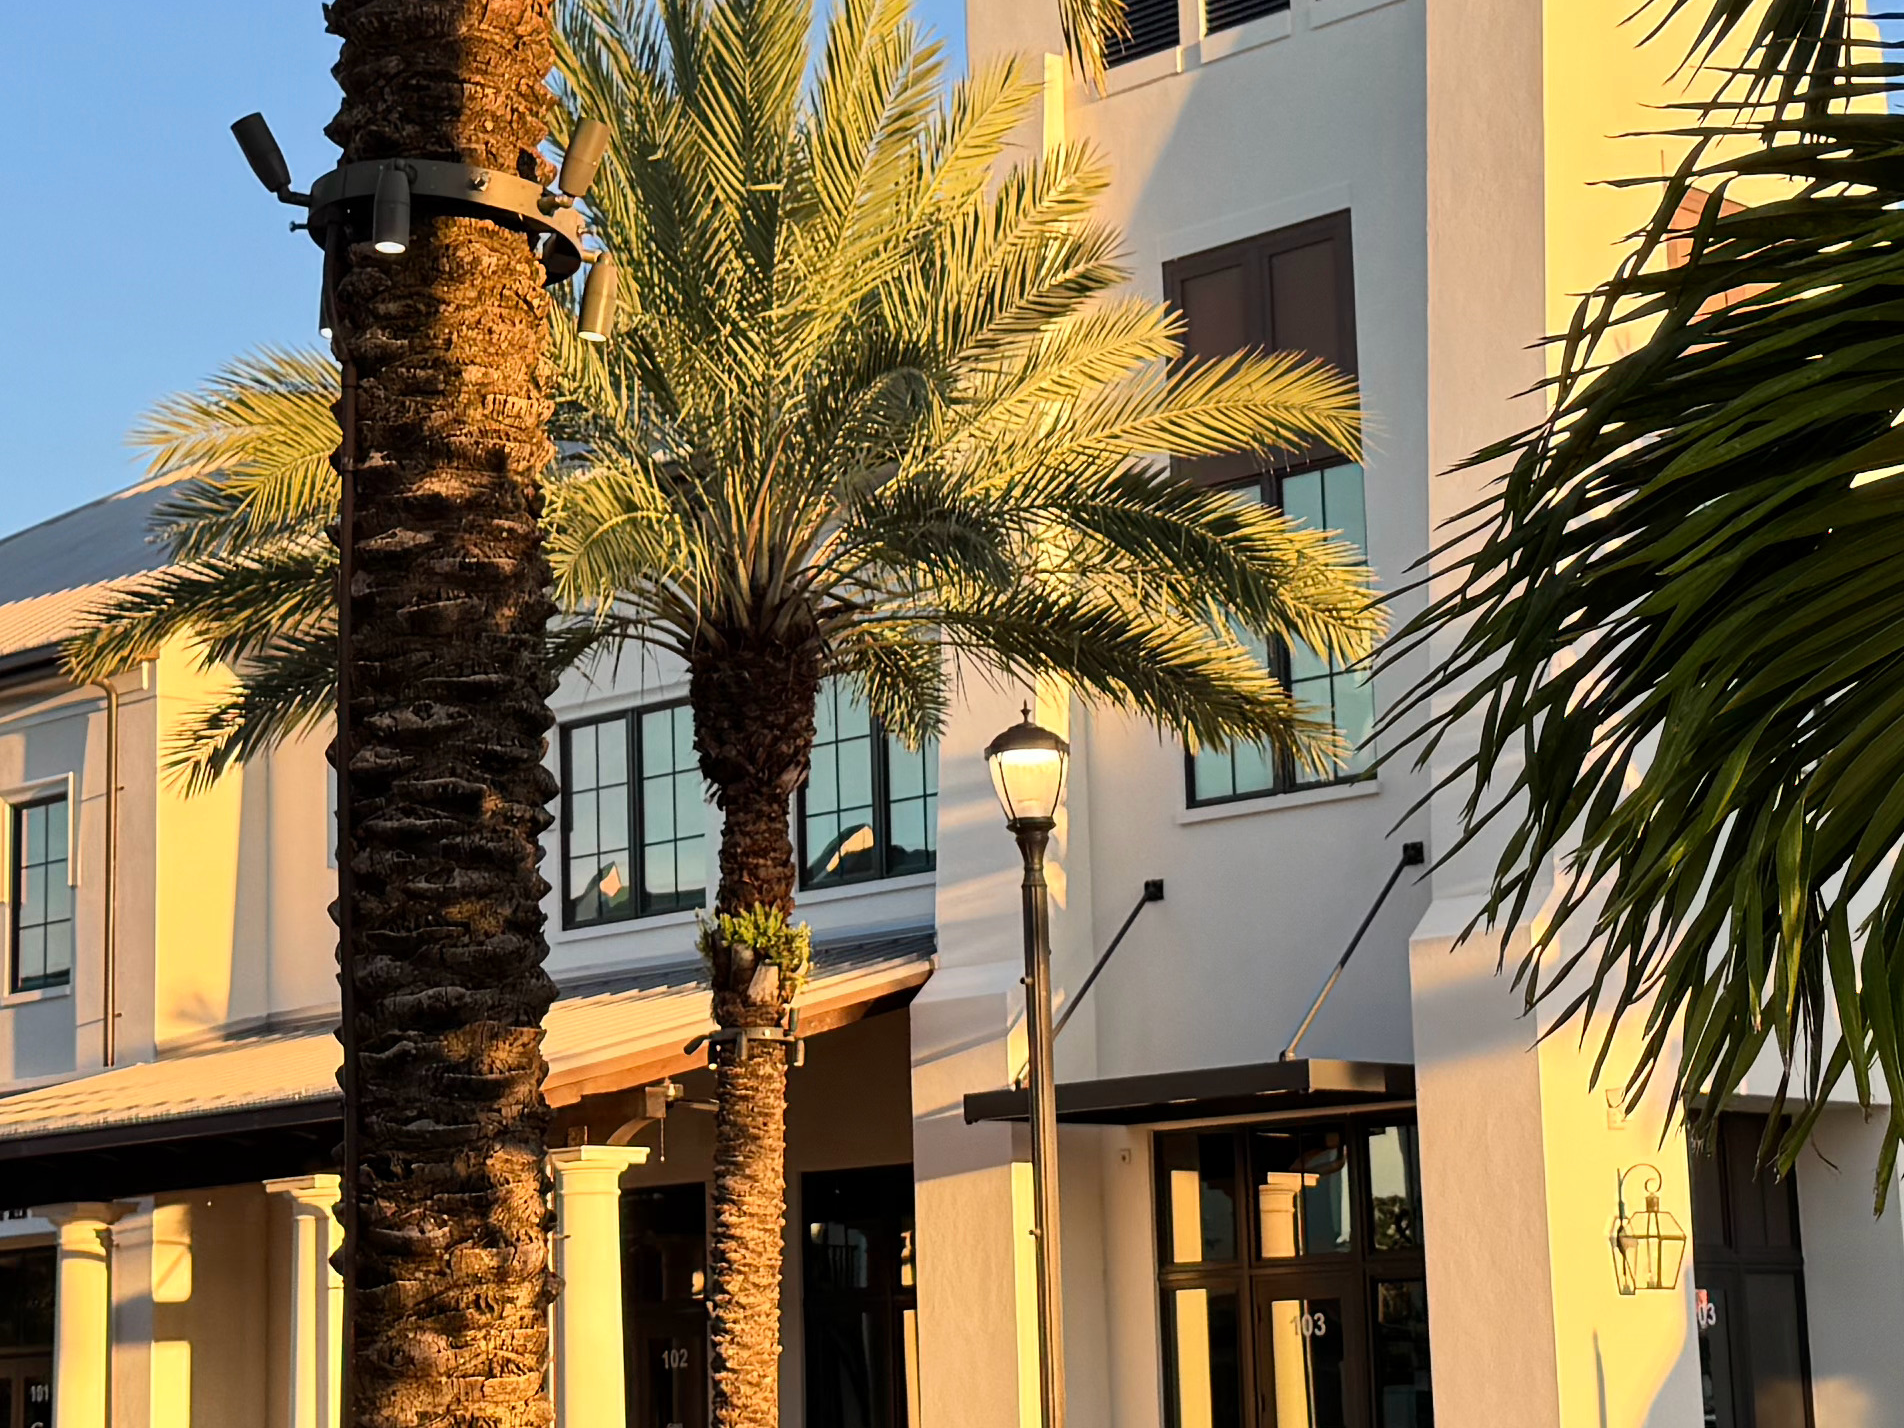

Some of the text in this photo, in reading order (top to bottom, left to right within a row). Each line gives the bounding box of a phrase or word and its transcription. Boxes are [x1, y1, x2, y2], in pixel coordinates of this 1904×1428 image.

[1289, 1312, 1327, 1336] 103
[1697, 1302, 1717, 1329] 03
[661, 1348, 689, 1370] 102
[30, 1384, 49, 1403] 101
